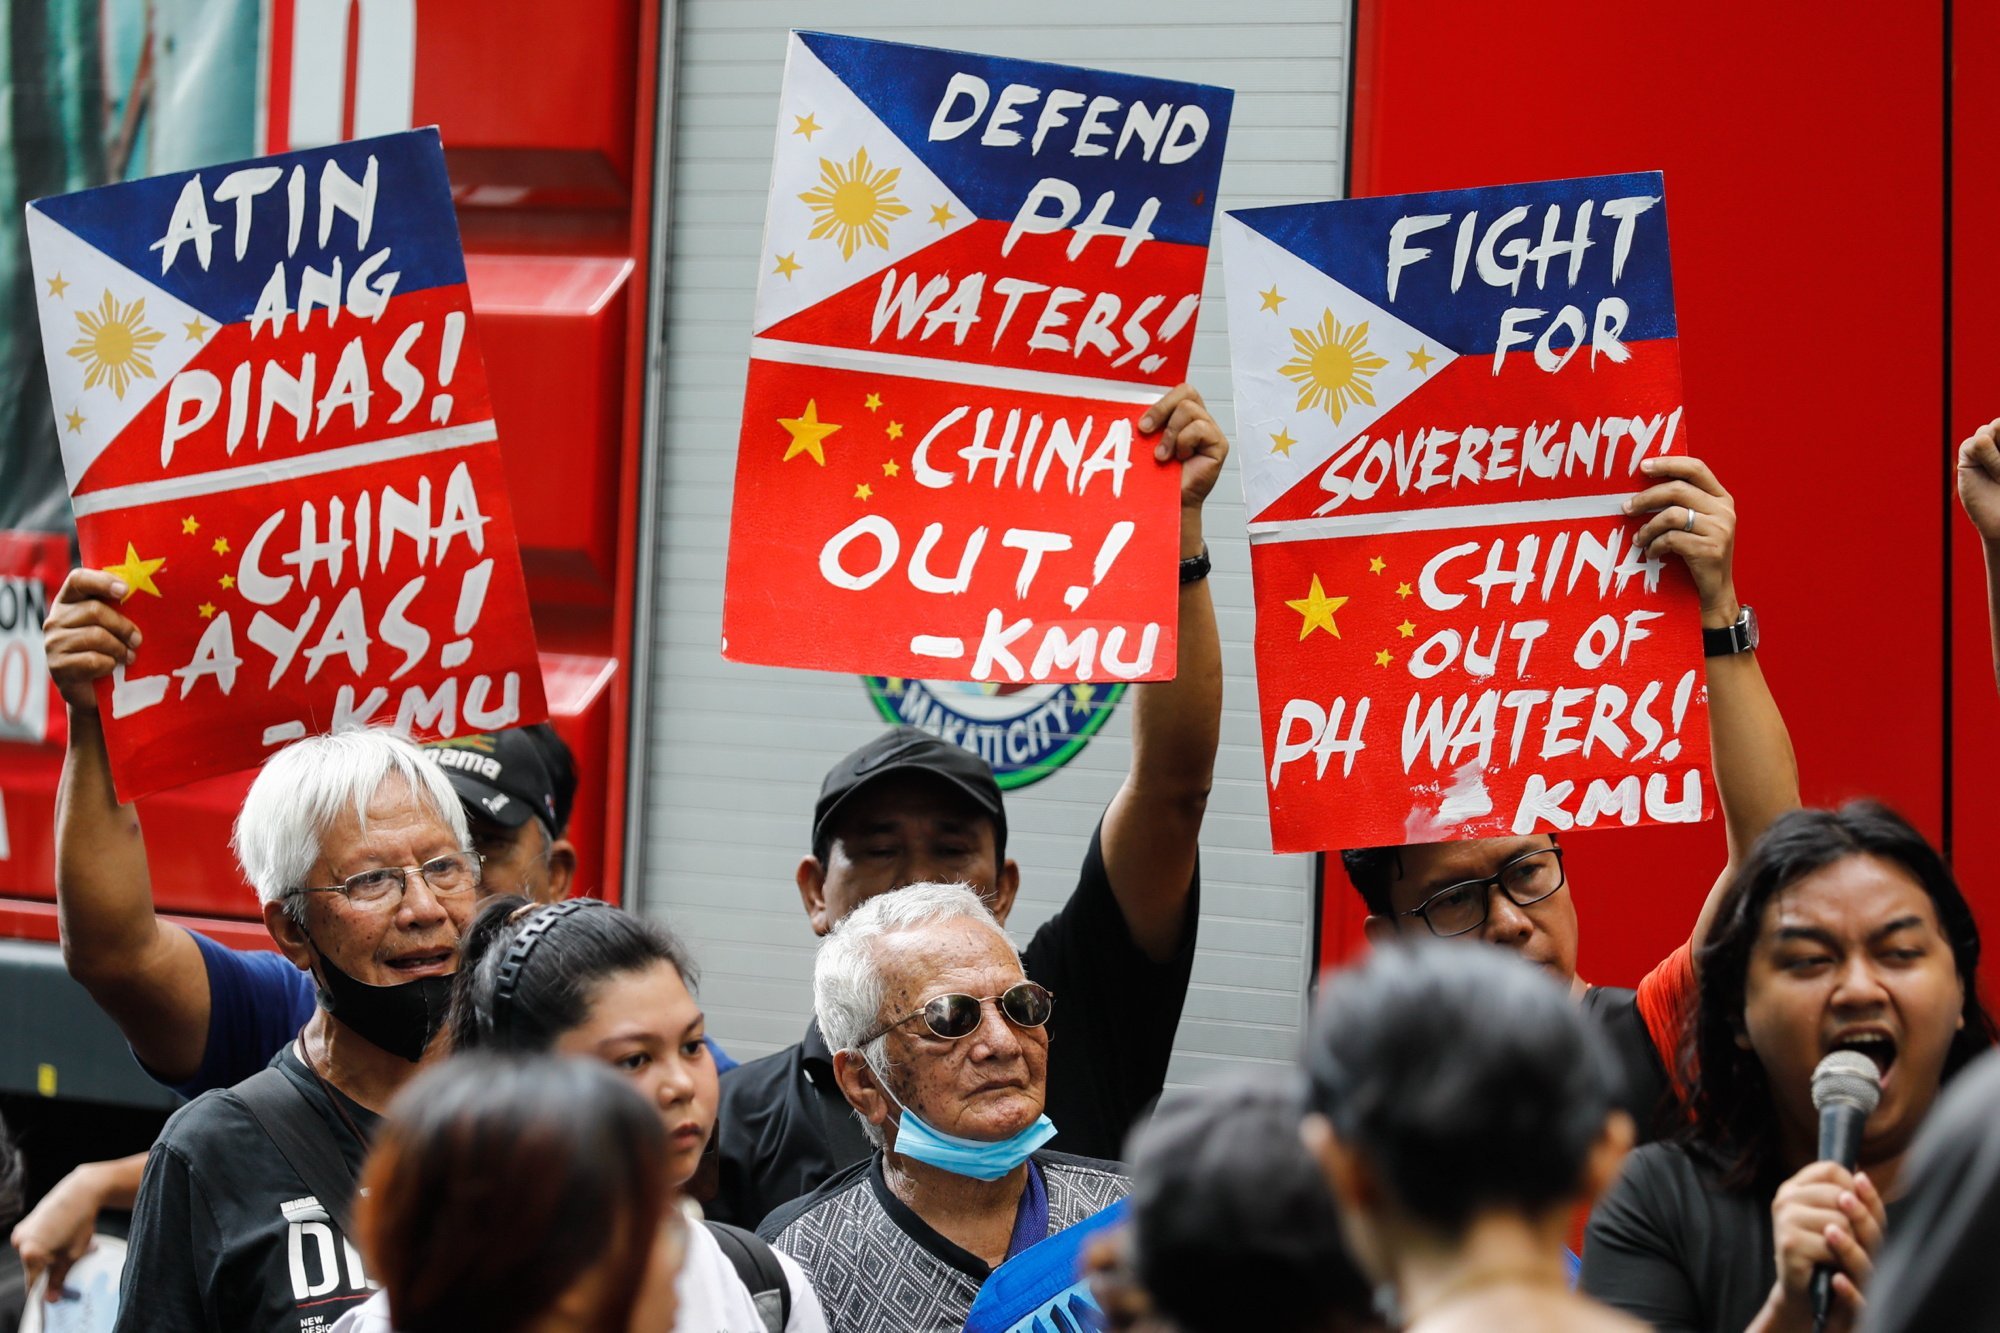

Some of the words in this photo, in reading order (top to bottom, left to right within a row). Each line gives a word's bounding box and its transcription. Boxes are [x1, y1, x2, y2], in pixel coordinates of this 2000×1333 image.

[929, 71, 1210, 165] DEFEND
[150, 154, 379, 275] ATIN
[1001, 177, 1162, 268] PH
[1386, 196, 1663, 304] FIGHT
[244, 247, 401, 341] ANG
[870, 268, 1201, 375] WATERS!
[1492, 297, 1633, 377] FOR
[160, 311, 467, 470] PINAS!
[911, 405, 1134, 498] CHINA
[1312, 405, 1684, 516] SOVEREIGNTY!
[236, 461, 493, 606] CHINA
[818, 513, 1136, 612] OUT!
[1418, 525, 1667, 609] CHINA
[112, 557, 495, 719] LAYAS!
[1408, 618, 1549, 680] OUT
[1573, 609, 1665, 671] OF
[1005, 690, 1071, 763] CITY
[1269, 695, 1371, 791] PH
[1401, 669, 1696, 775] WATERS!
[300, 1315, 324, 1328] NEW
